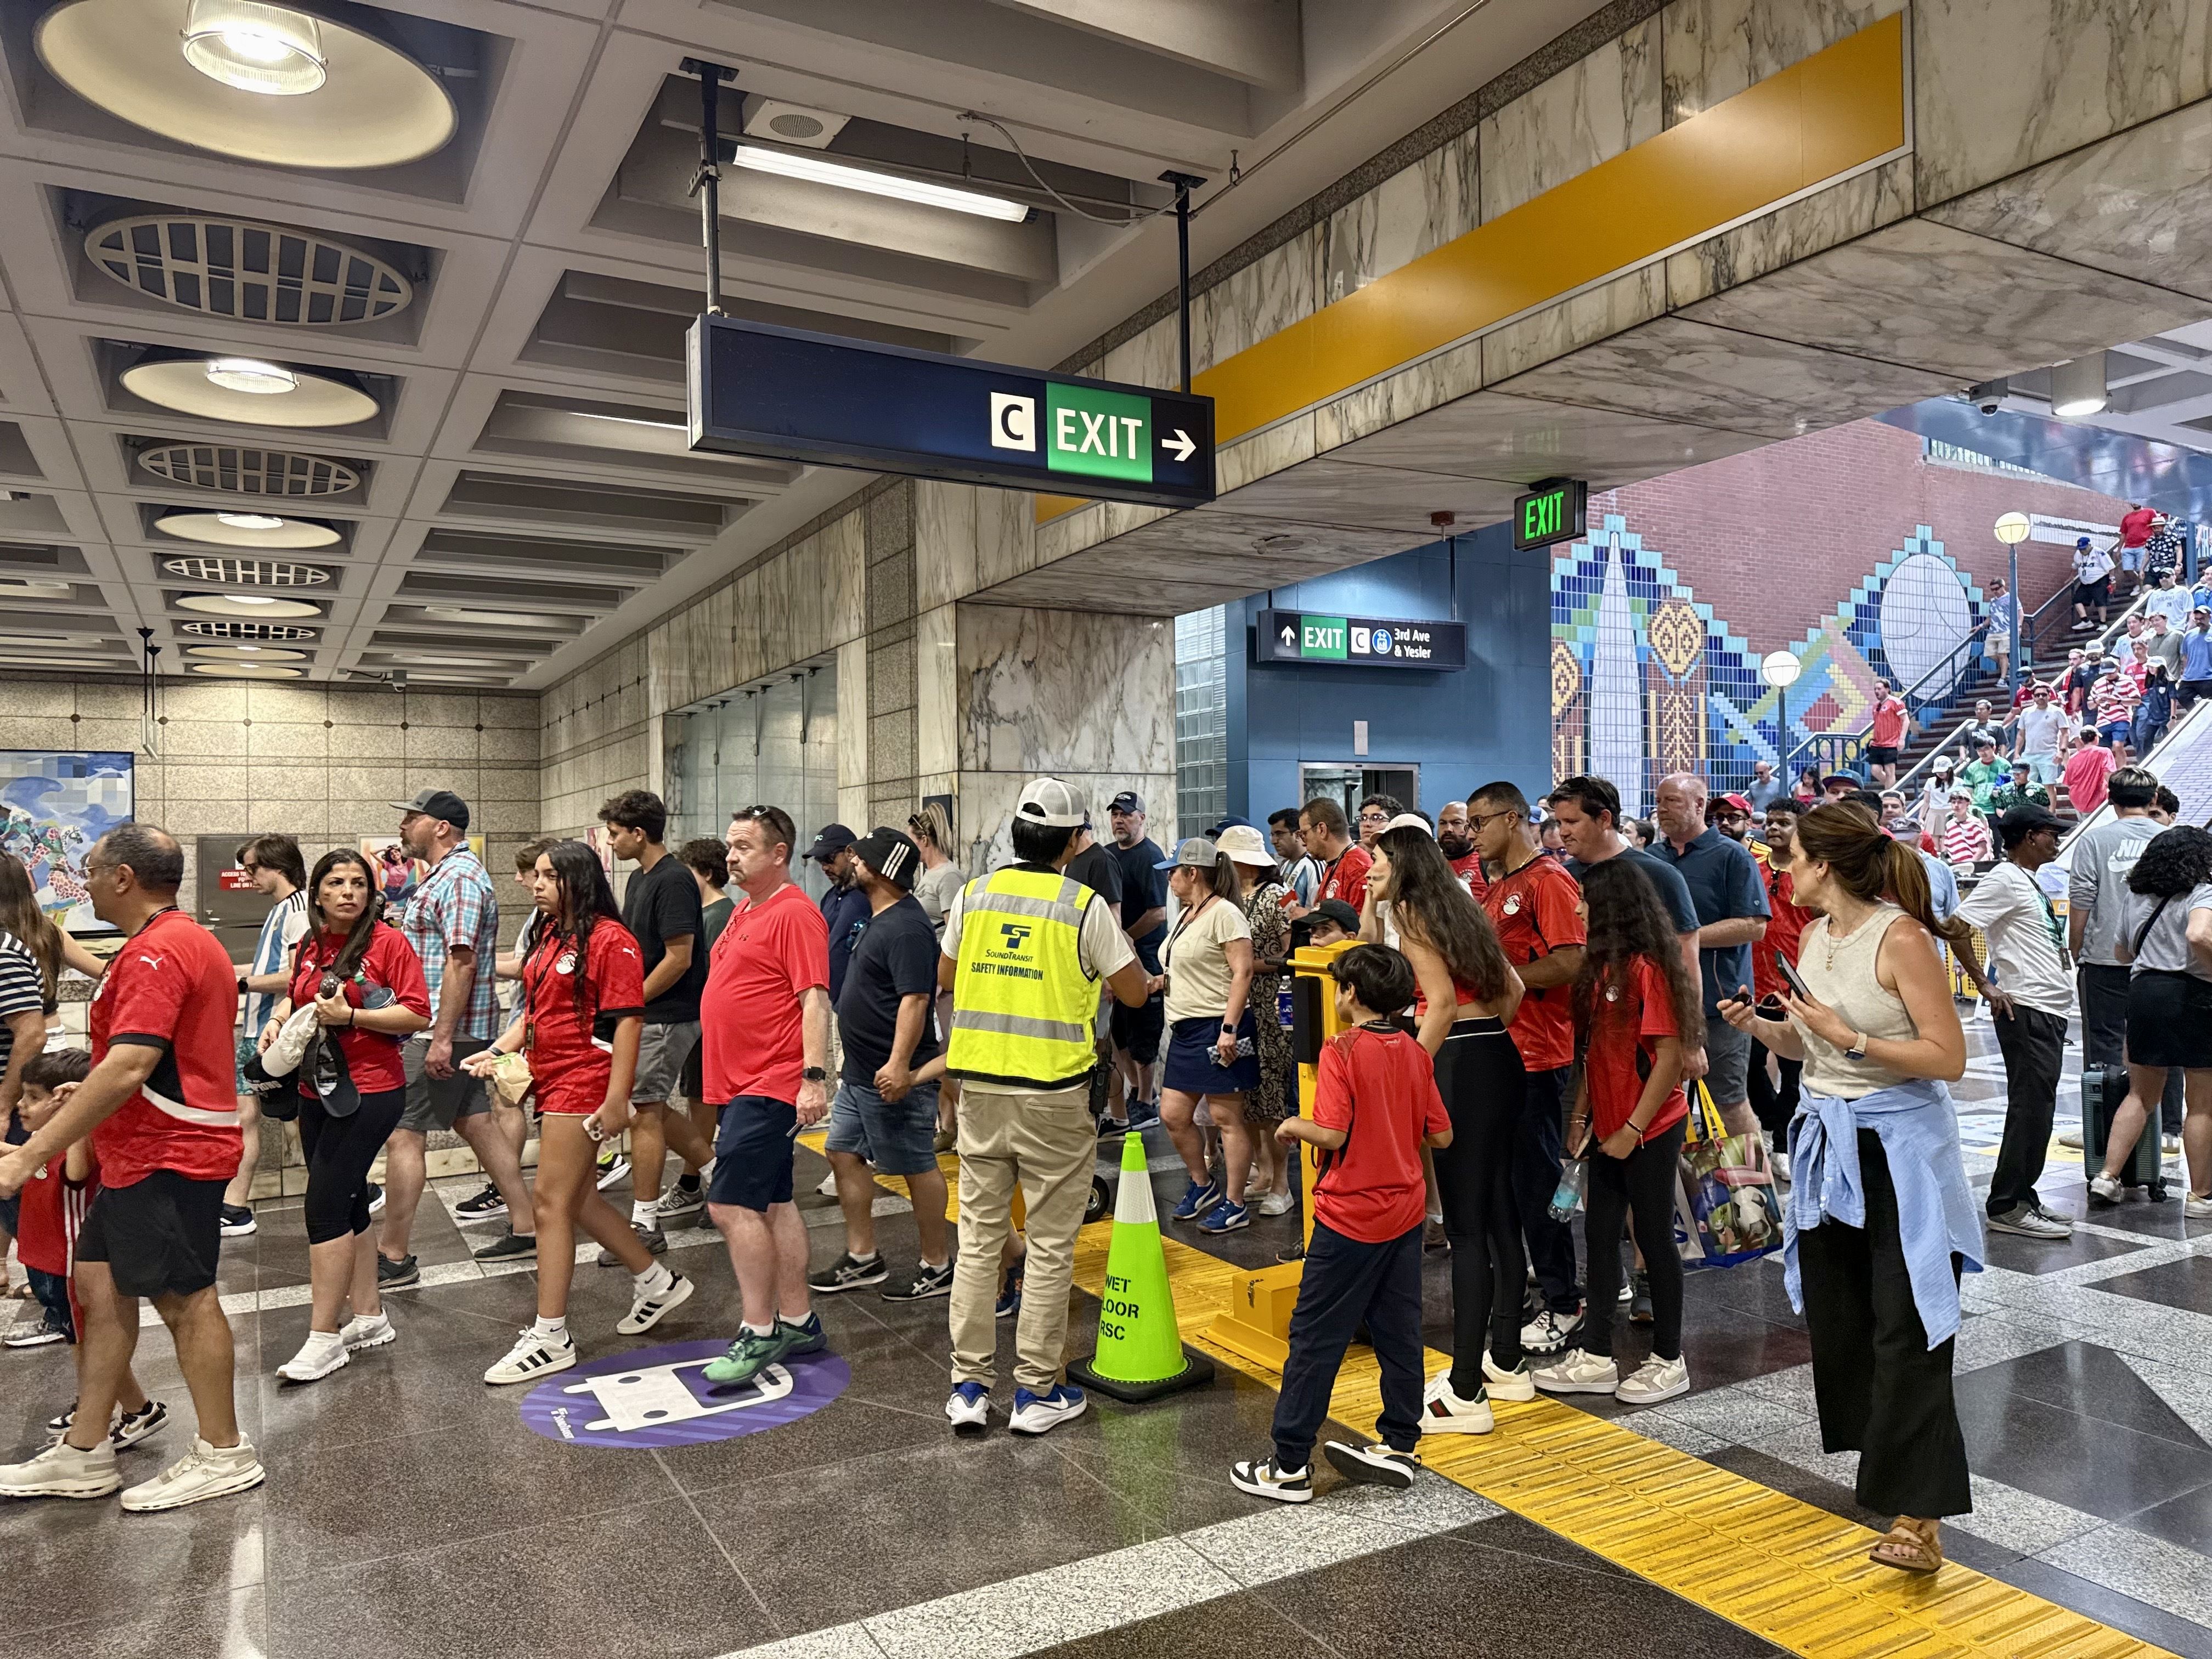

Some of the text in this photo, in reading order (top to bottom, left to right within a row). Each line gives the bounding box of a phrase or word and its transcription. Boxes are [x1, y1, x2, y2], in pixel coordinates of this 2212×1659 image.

[1001, 404, 1142, 460] C EXIT
[1525, 491, 1564, 540] EXIT
[1304, 627, 1365, 650] EXIT C
[1394, 628, 1430, 642] 3rd Ave
[1394, 646, 1432, 659] & Yesler
[971, 962, 1043, 980] SAFETY INFORMATION
